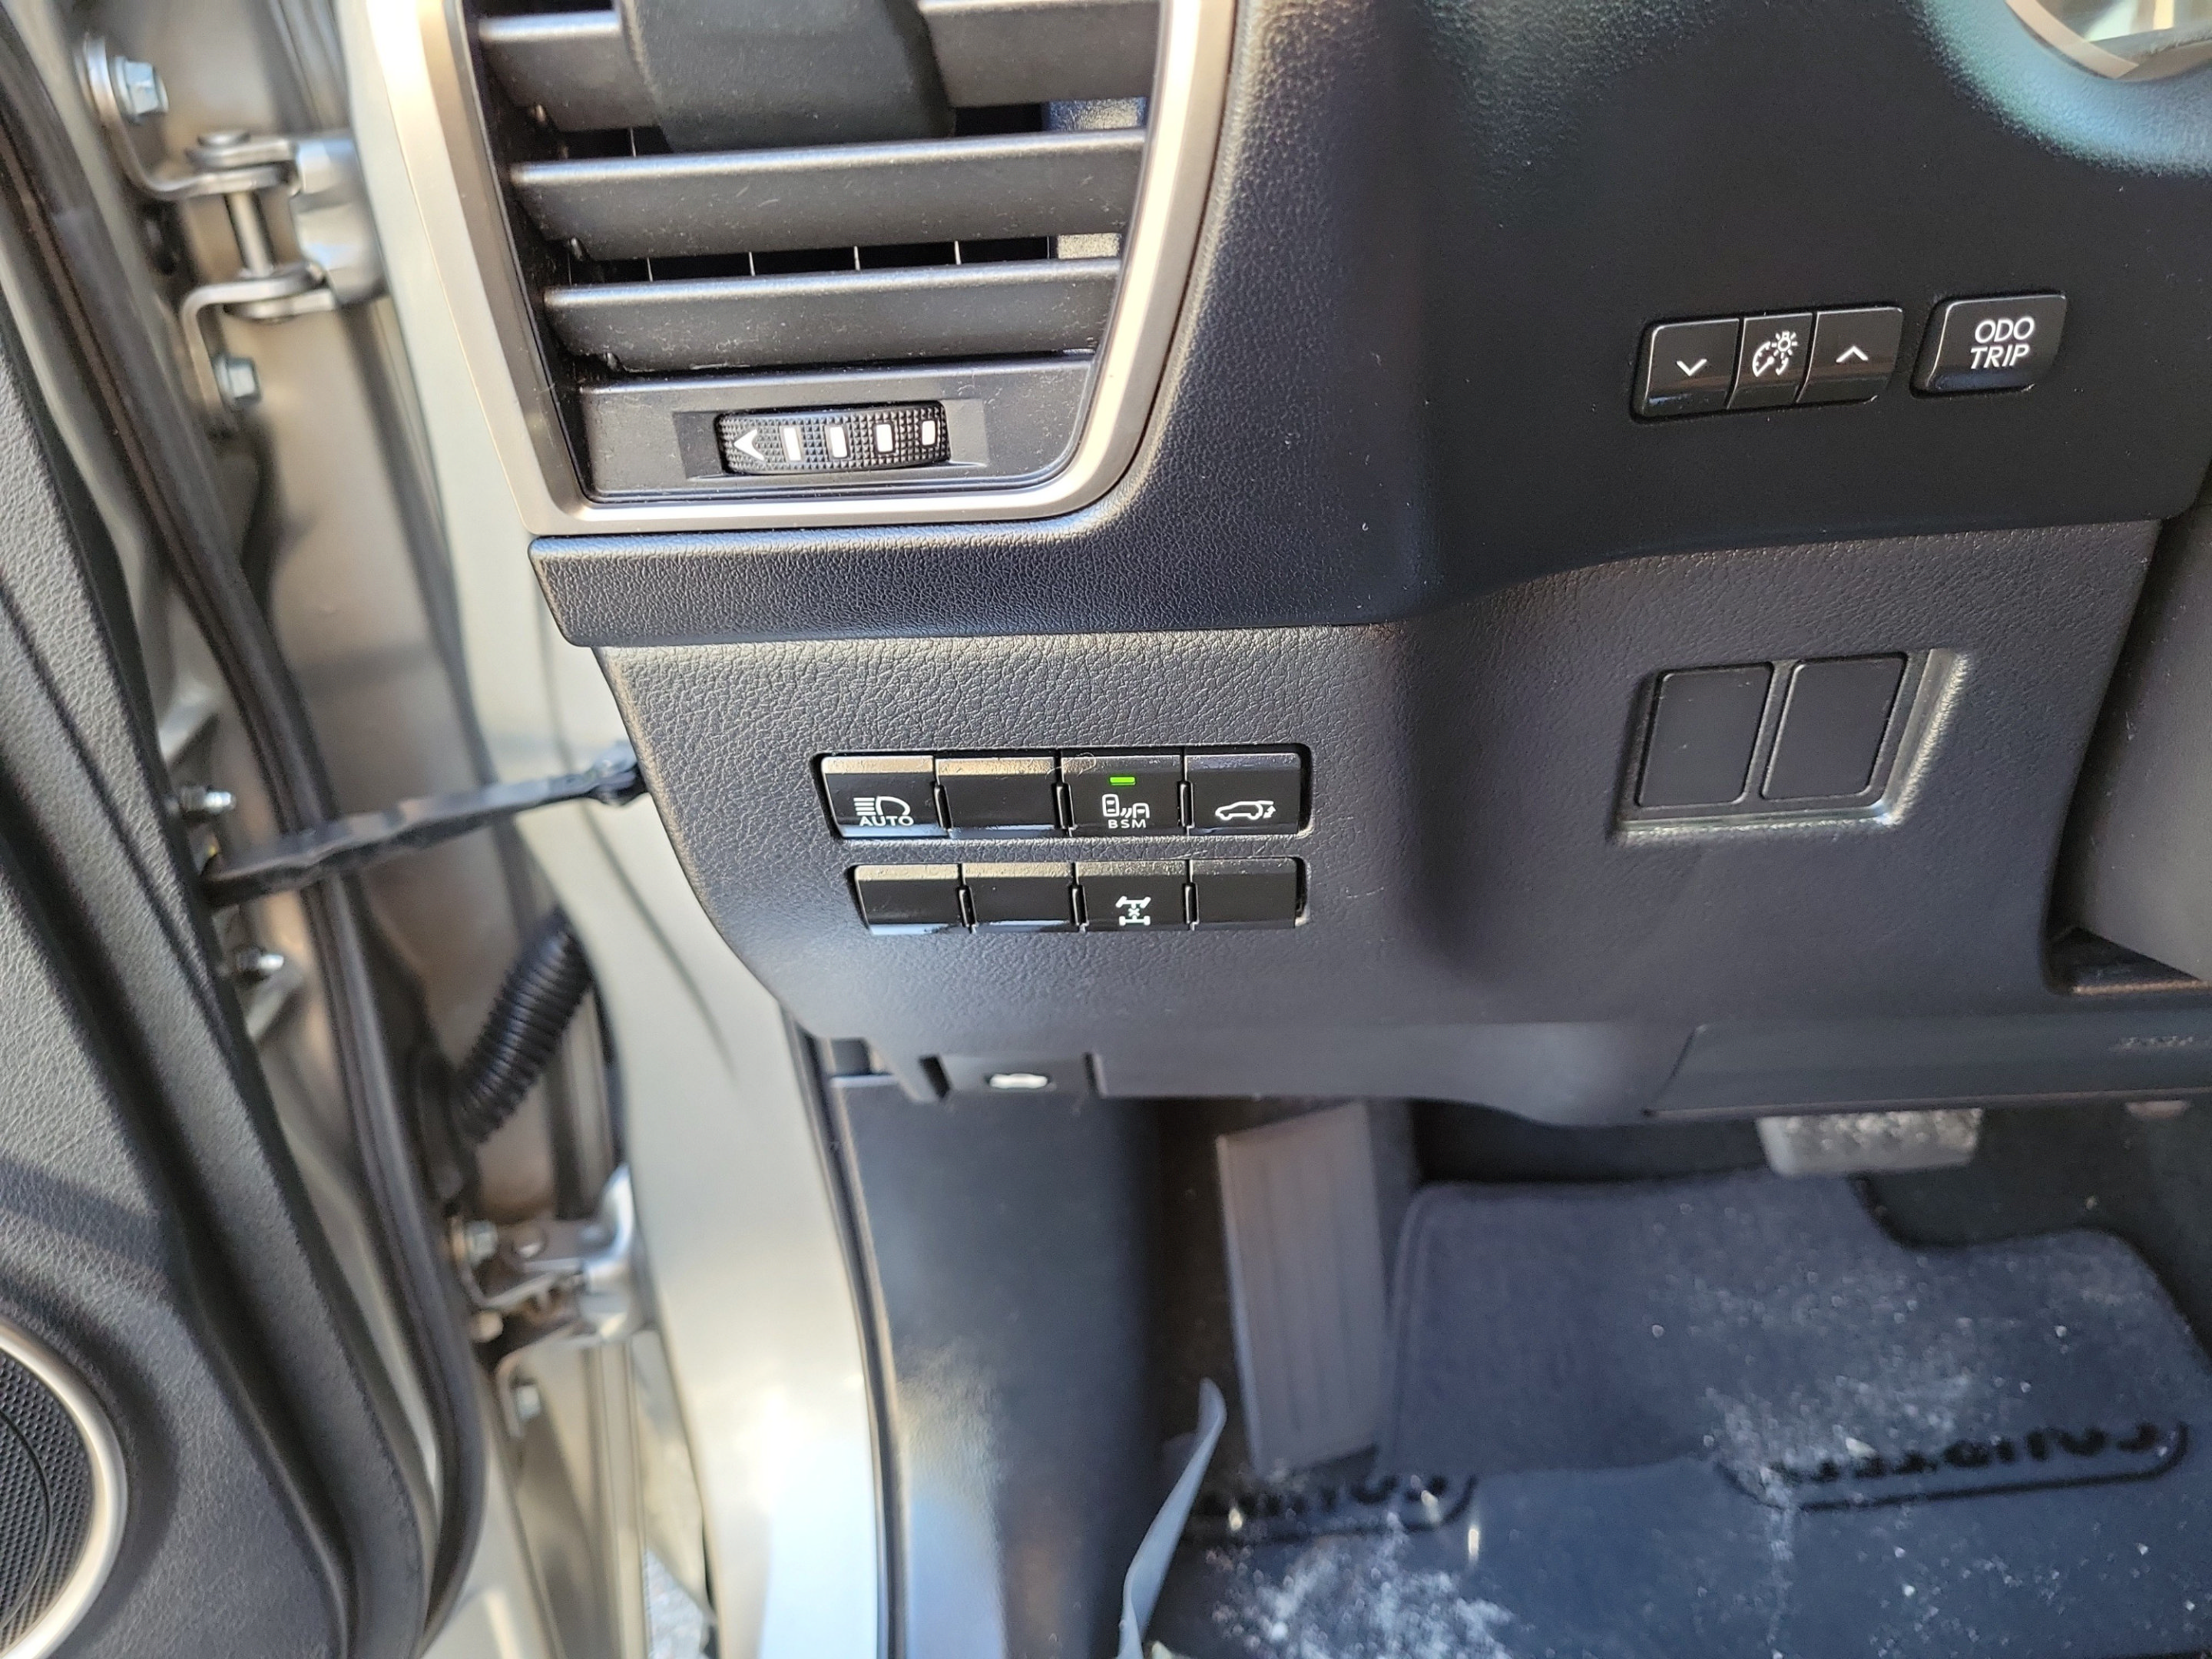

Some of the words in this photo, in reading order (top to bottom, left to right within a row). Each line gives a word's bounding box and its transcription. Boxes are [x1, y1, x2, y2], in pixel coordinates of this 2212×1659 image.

[1975, 316, 2035, 344] ODO
[1970, 343, 2031, 369] TRIP
[859, 816, 914, 826] AUTO
[1108, 819, 1147, 829] BSM
